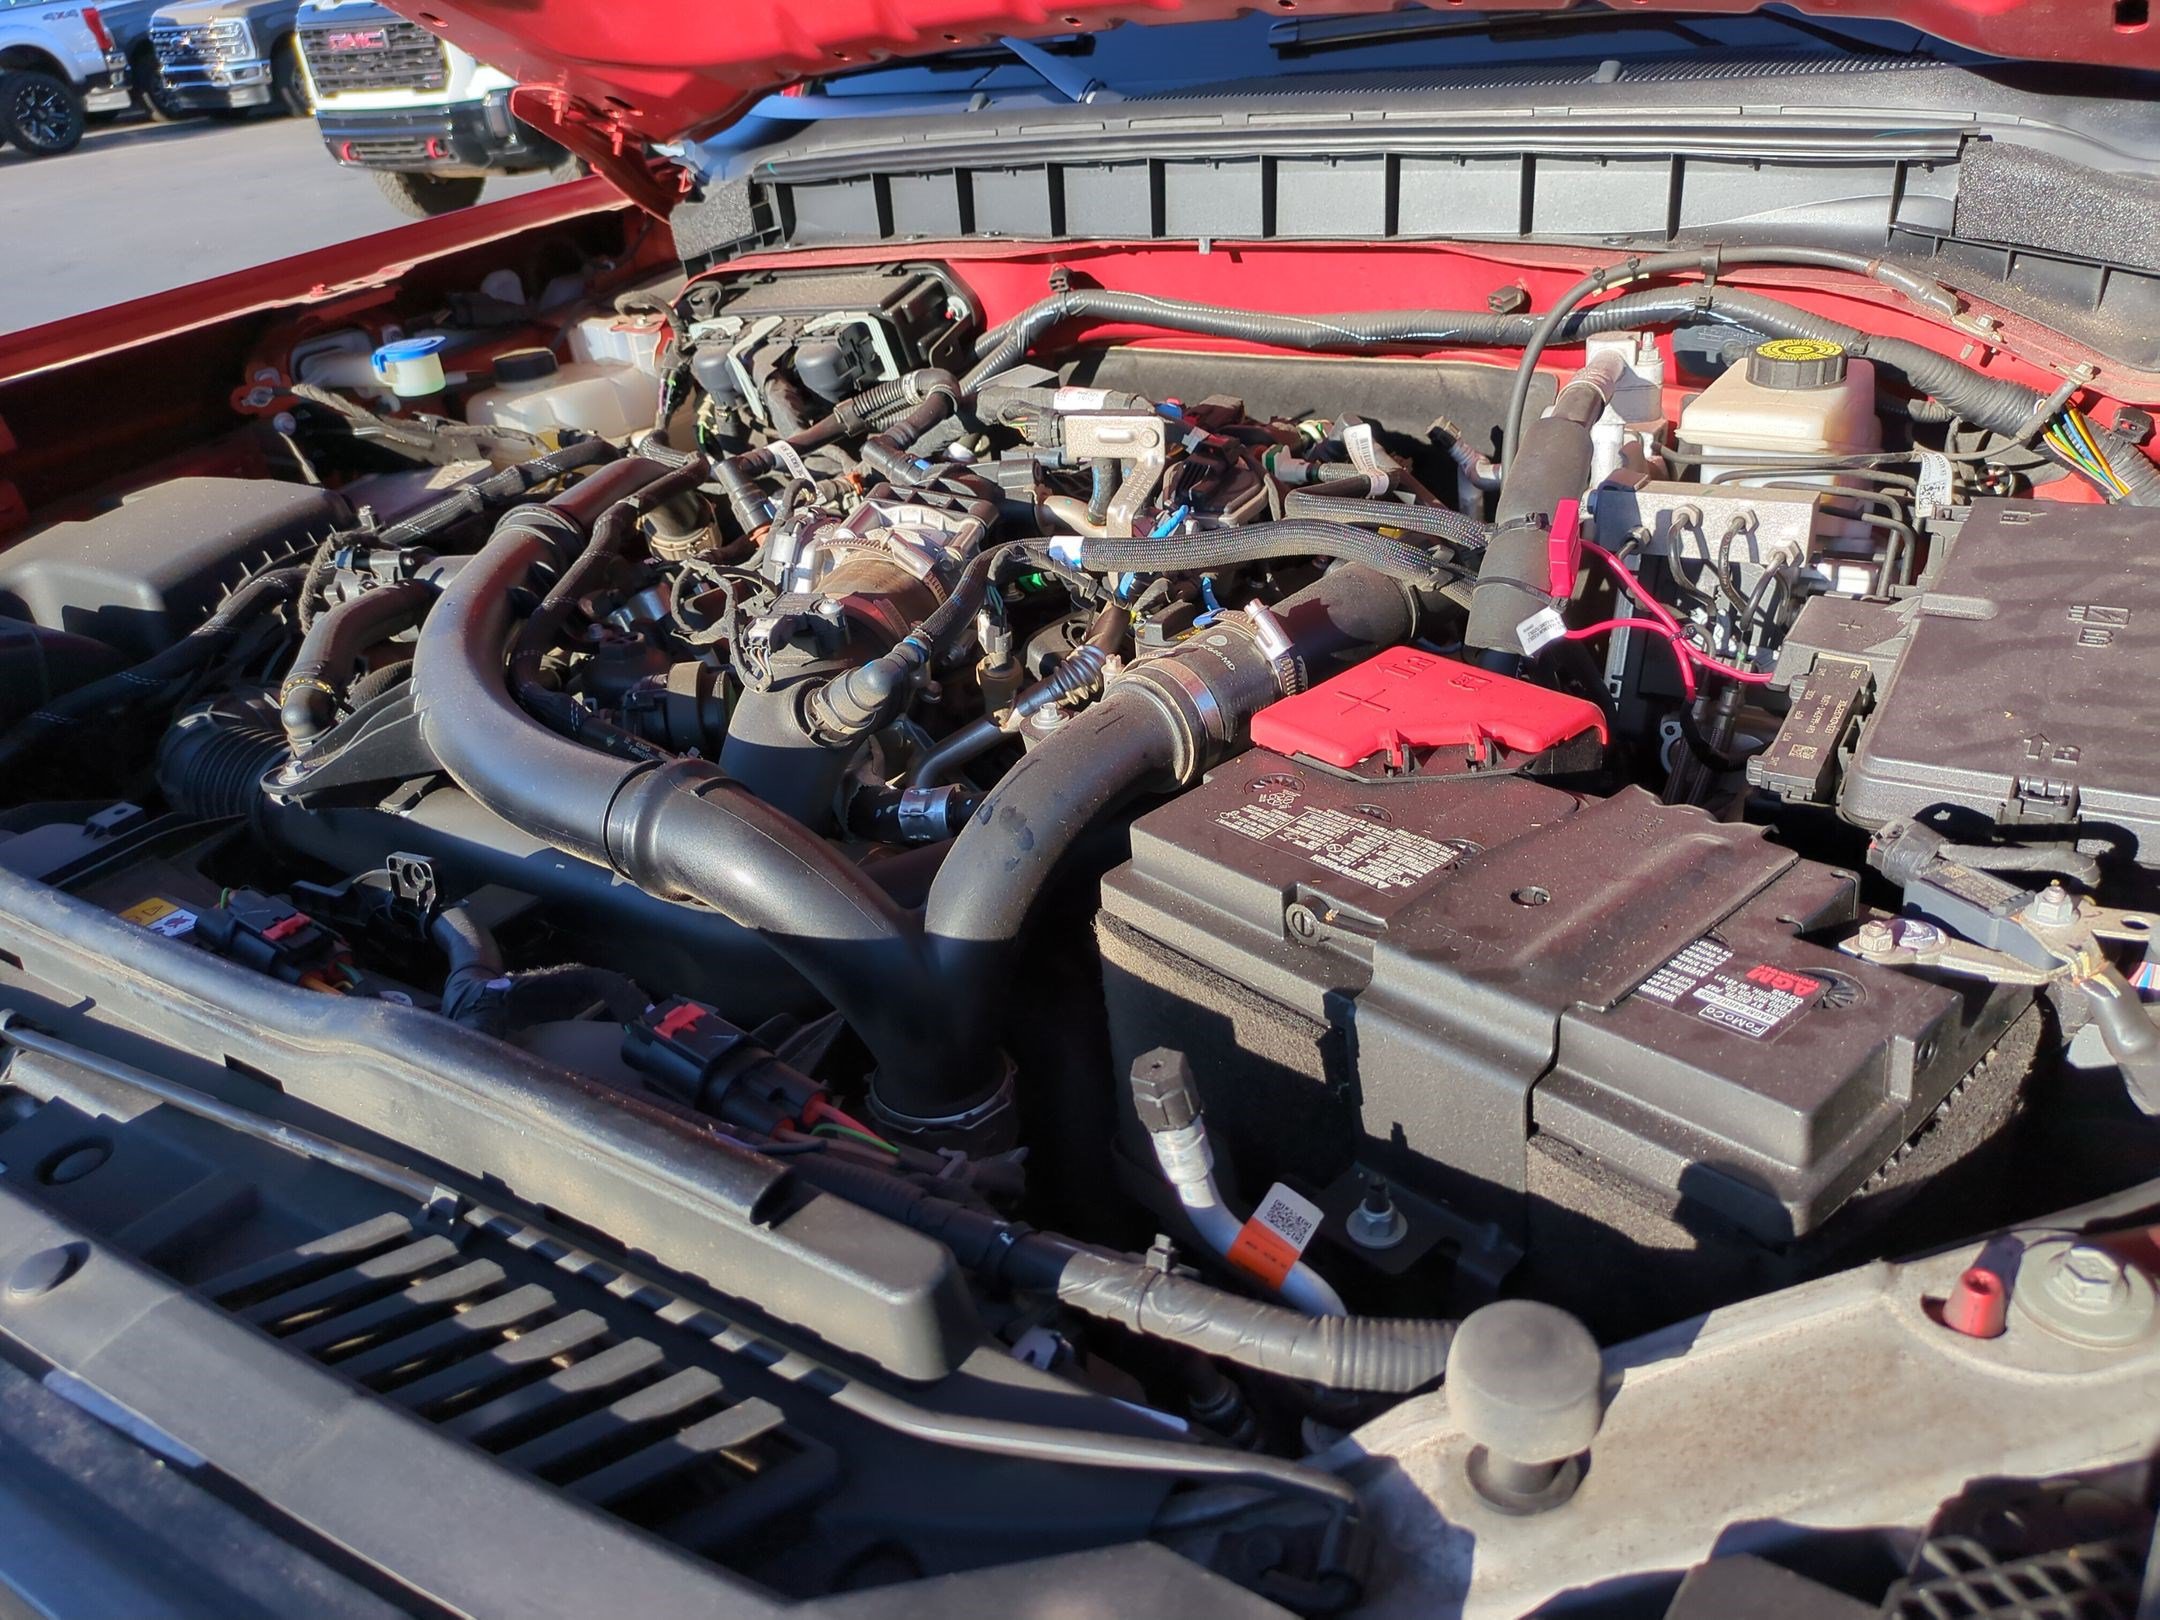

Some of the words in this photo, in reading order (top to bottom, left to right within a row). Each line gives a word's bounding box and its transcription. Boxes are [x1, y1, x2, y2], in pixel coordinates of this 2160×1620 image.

[328, 31, 384, 50] GMC
[1310, 854, 1379, 884] DANGER/POISON
[1745, 968, 1816, 995] AGM
[1738, 989, 1767, 1002] MOTOR
[1769, 1001, 1792, 1012] FORD
[1706, 1007, 1764, 1033] FoMoCo
